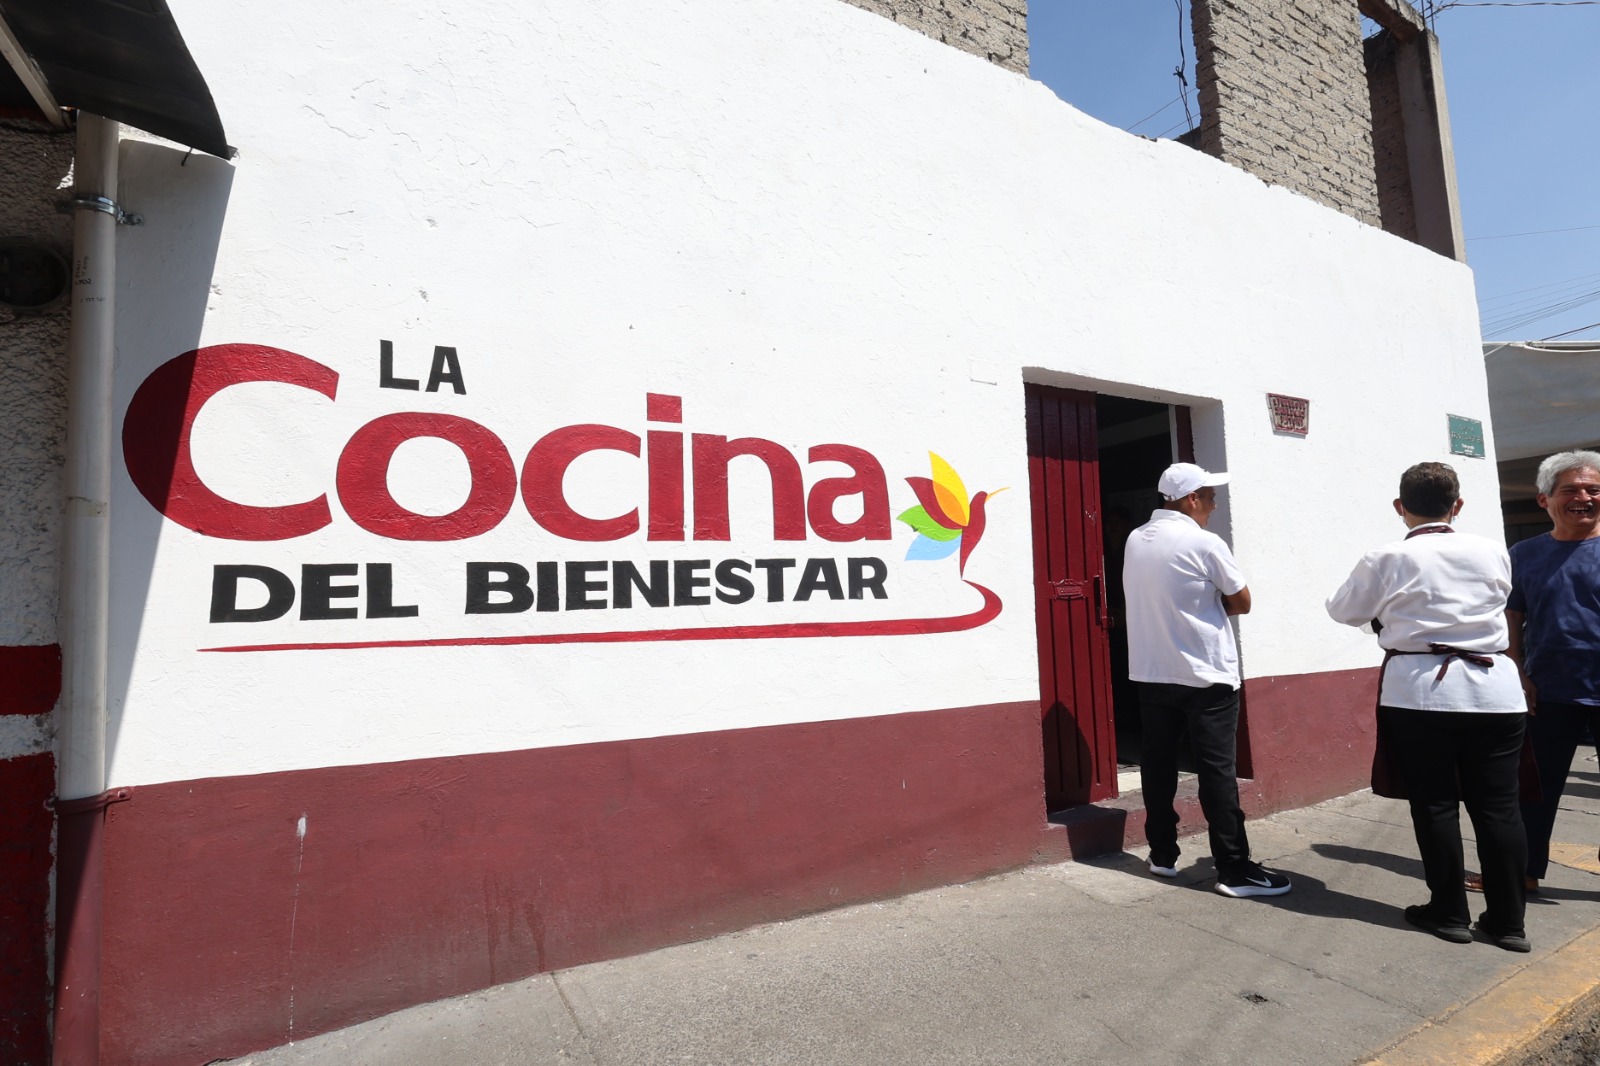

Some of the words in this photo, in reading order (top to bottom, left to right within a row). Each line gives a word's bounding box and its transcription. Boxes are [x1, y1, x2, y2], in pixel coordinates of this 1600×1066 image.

[380, 340, 466, 394] LA
[123, 344, 891, 541] Cocina
[210, 563, 418, 623] DEL
[465, 557, 888, 614] BIENESTAR
